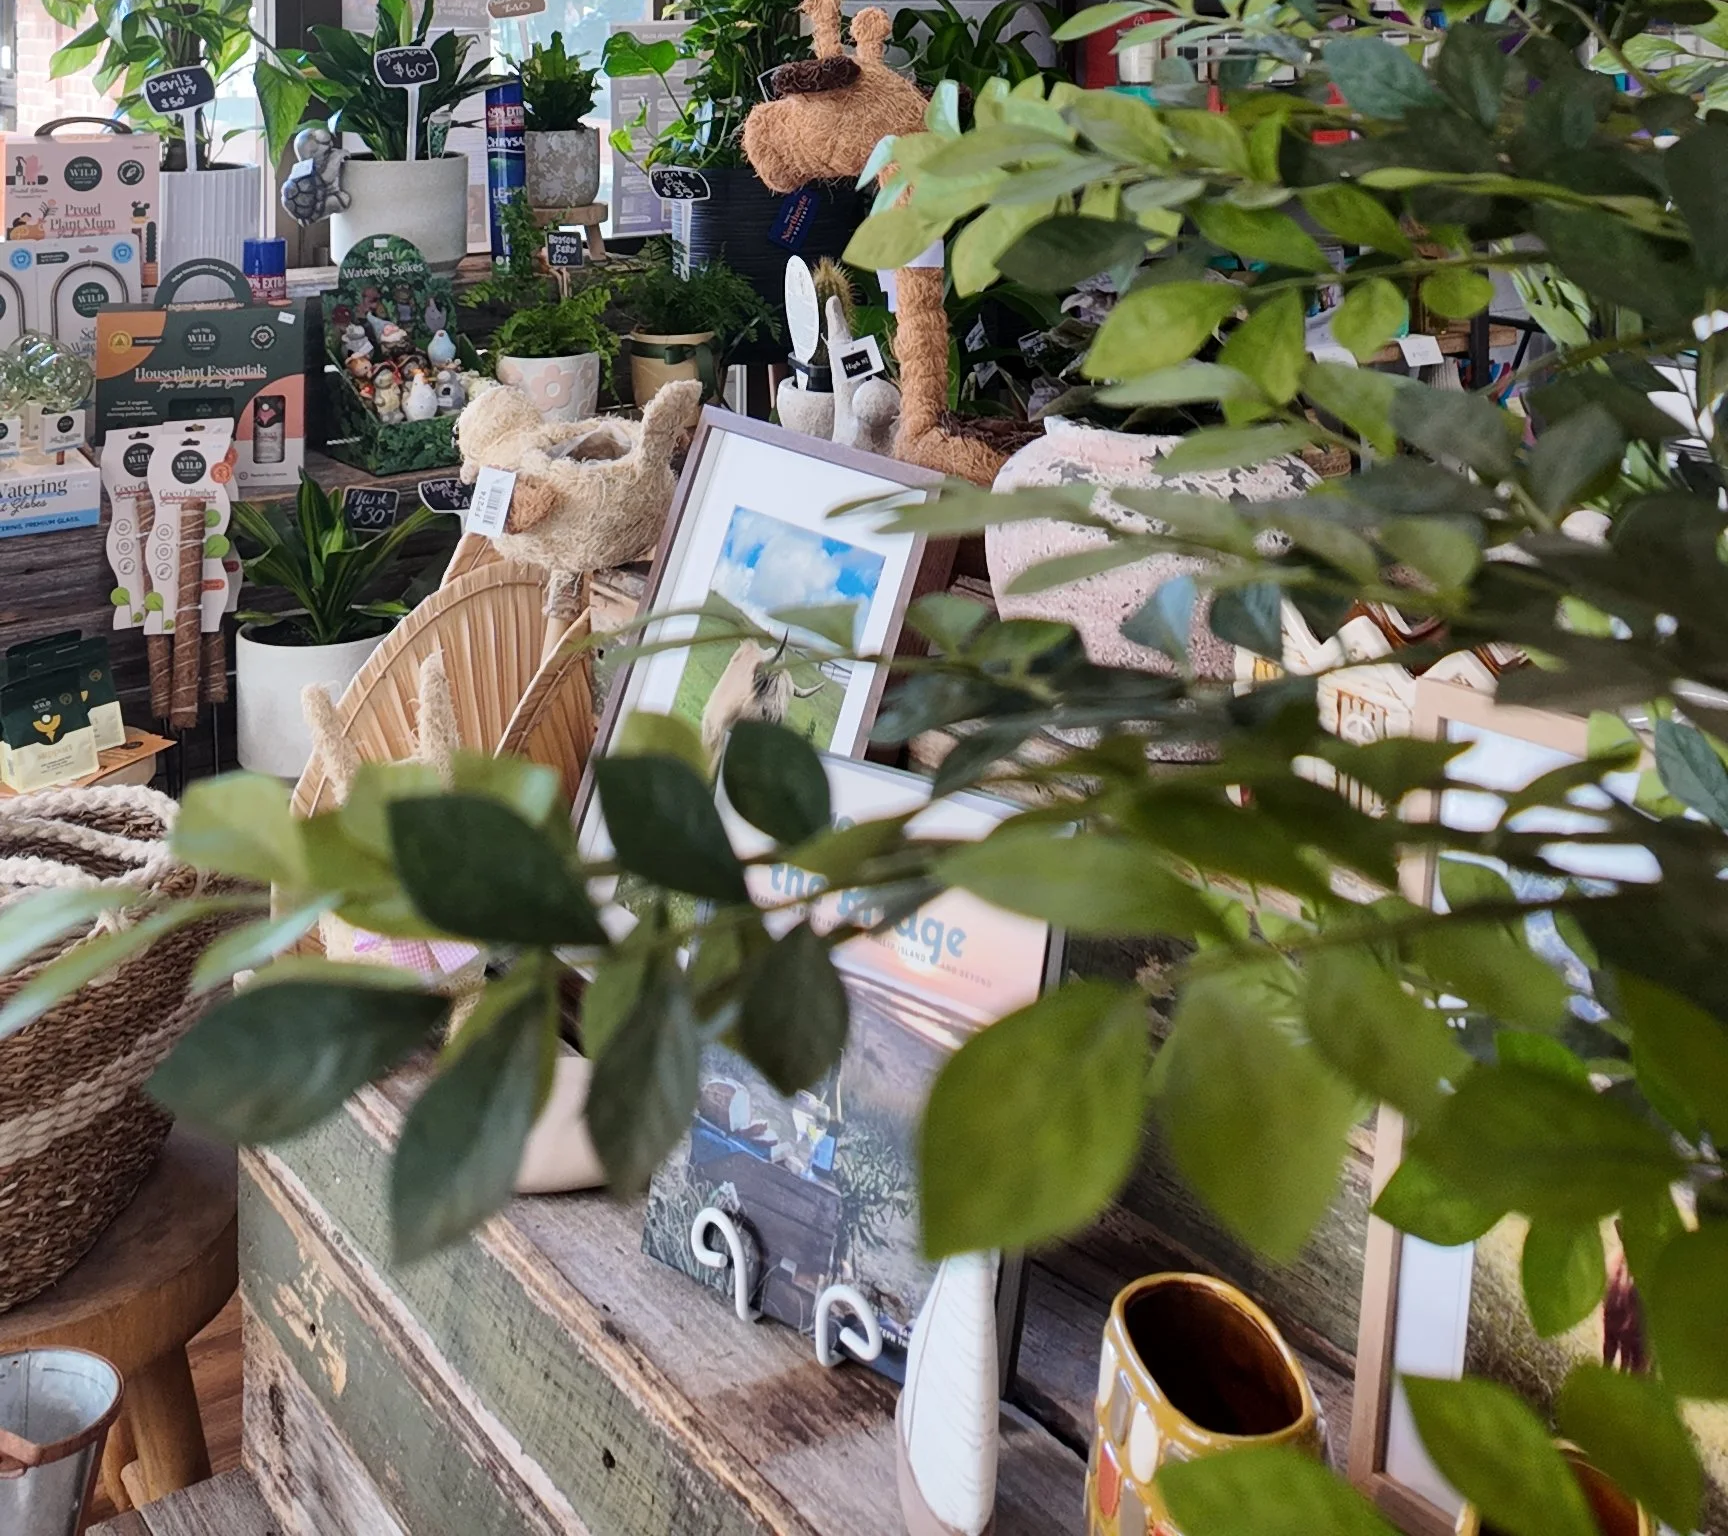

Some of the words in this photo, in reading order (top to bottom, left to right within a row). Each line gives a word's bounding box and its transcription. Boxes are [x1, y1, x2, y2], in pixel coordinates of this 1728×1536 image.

[161, 96, 185, 109] $50
[69, 167, 98, 177] WILD
[65, 203, 101, 216] Proud
[50, 218, 83, 231] Plant
[83, 216, 116, 230] Mum
[367, 250, 394, 262] Plant
[342, 265, 390, 278] Watering
[391, 262, 424, 276] Spikes
[77, 294, 105, 303] WILD
[187, 334, 216, 343] WILD
[134, 366, 205, 382] Houseplant
[207, 363, 268, 379] Essentials
[127, 453, 151, 463] WIL
[176, 461, 203, 470] WILD
[159, 489, 182, 499] Coco
